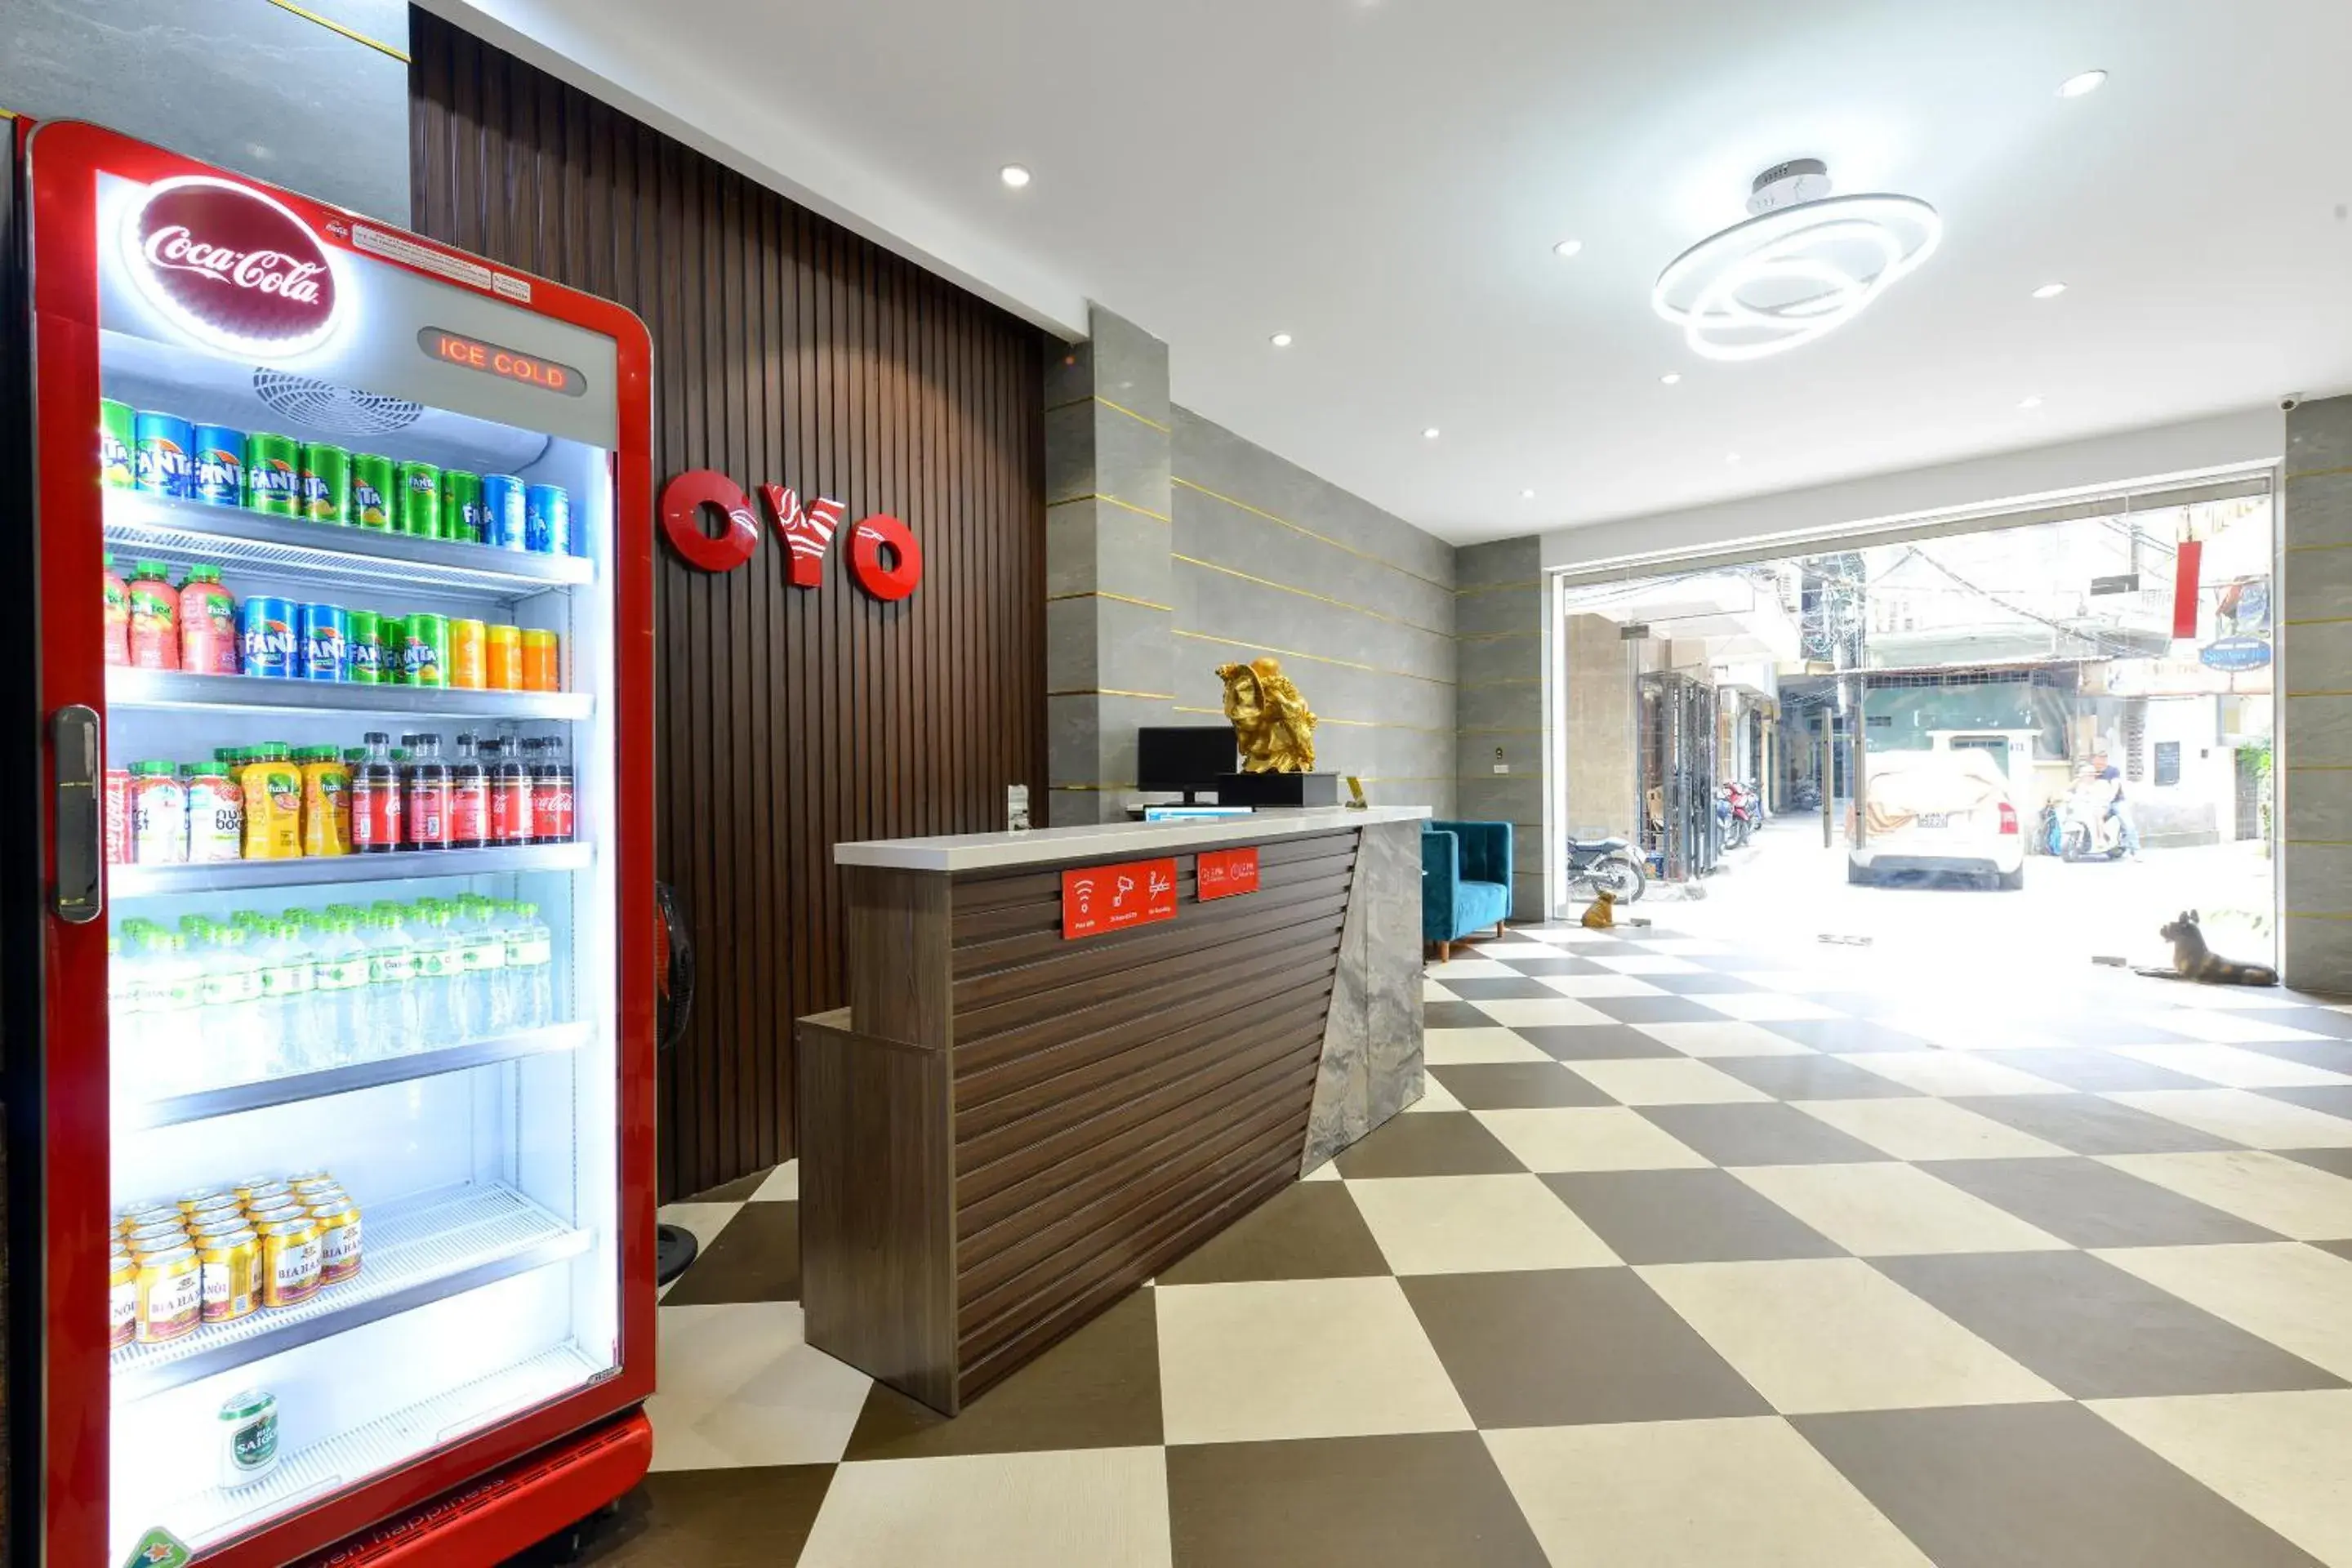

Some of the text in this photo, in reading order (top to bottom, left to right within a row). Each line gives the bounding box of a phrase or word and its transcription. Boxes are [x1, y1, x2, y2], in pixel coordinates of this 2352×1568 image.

[145, 226, 327, 305] Coca-Cola
[441, 337, 563, 387] ICE COLD
[657, 469, 922, 602] OYO
